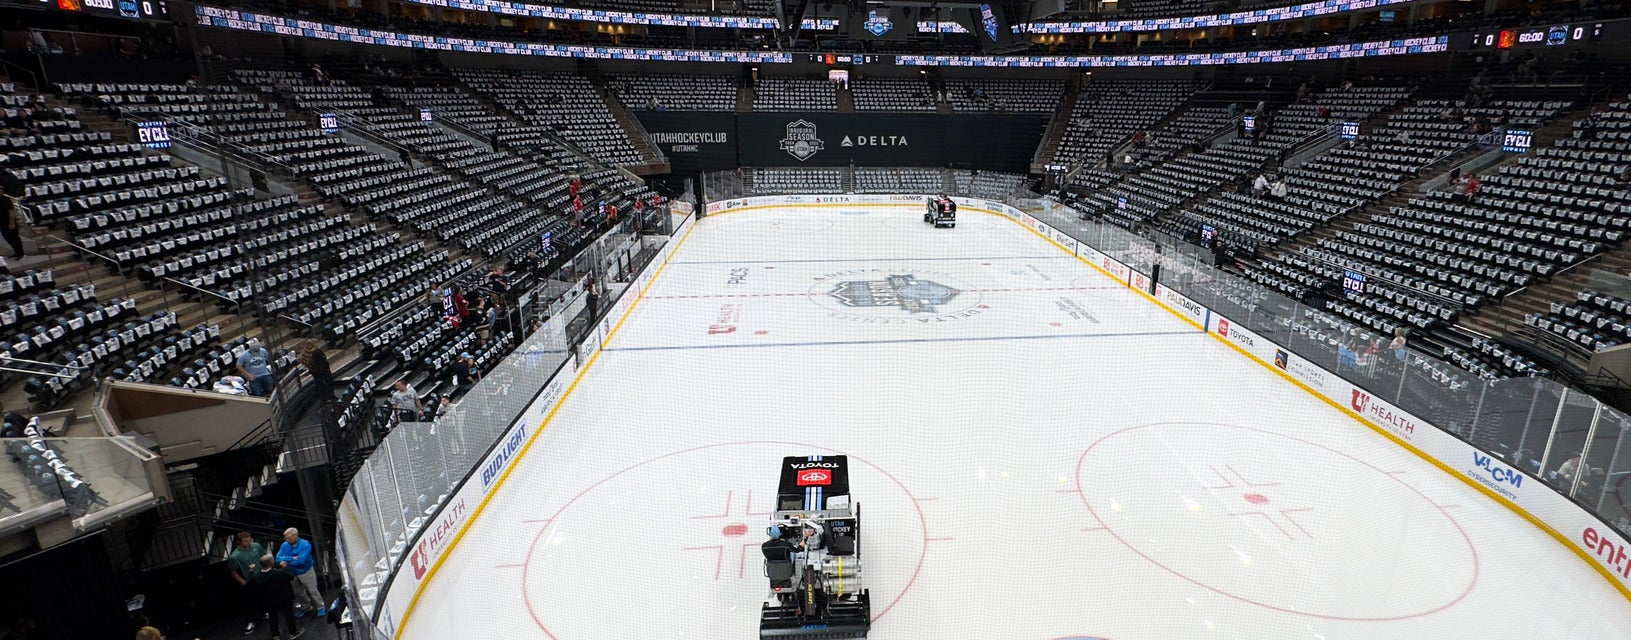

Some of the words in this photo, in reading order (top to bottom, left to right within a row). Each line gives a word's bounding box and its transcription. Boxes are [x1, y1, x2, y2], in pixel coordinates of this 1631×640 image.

[1519, 32, 1544, 42] 60:00
[857, 136, 908, 146] DELTA
[1230, 328, 1254, 347] TOYOTA
[1370, 402, 1414, 434] HEALTH
[482, 454, 503, 486] BUD
[503, 424, 527, 461] LIGHT
[429, 498, 466, 550] HEALTH
